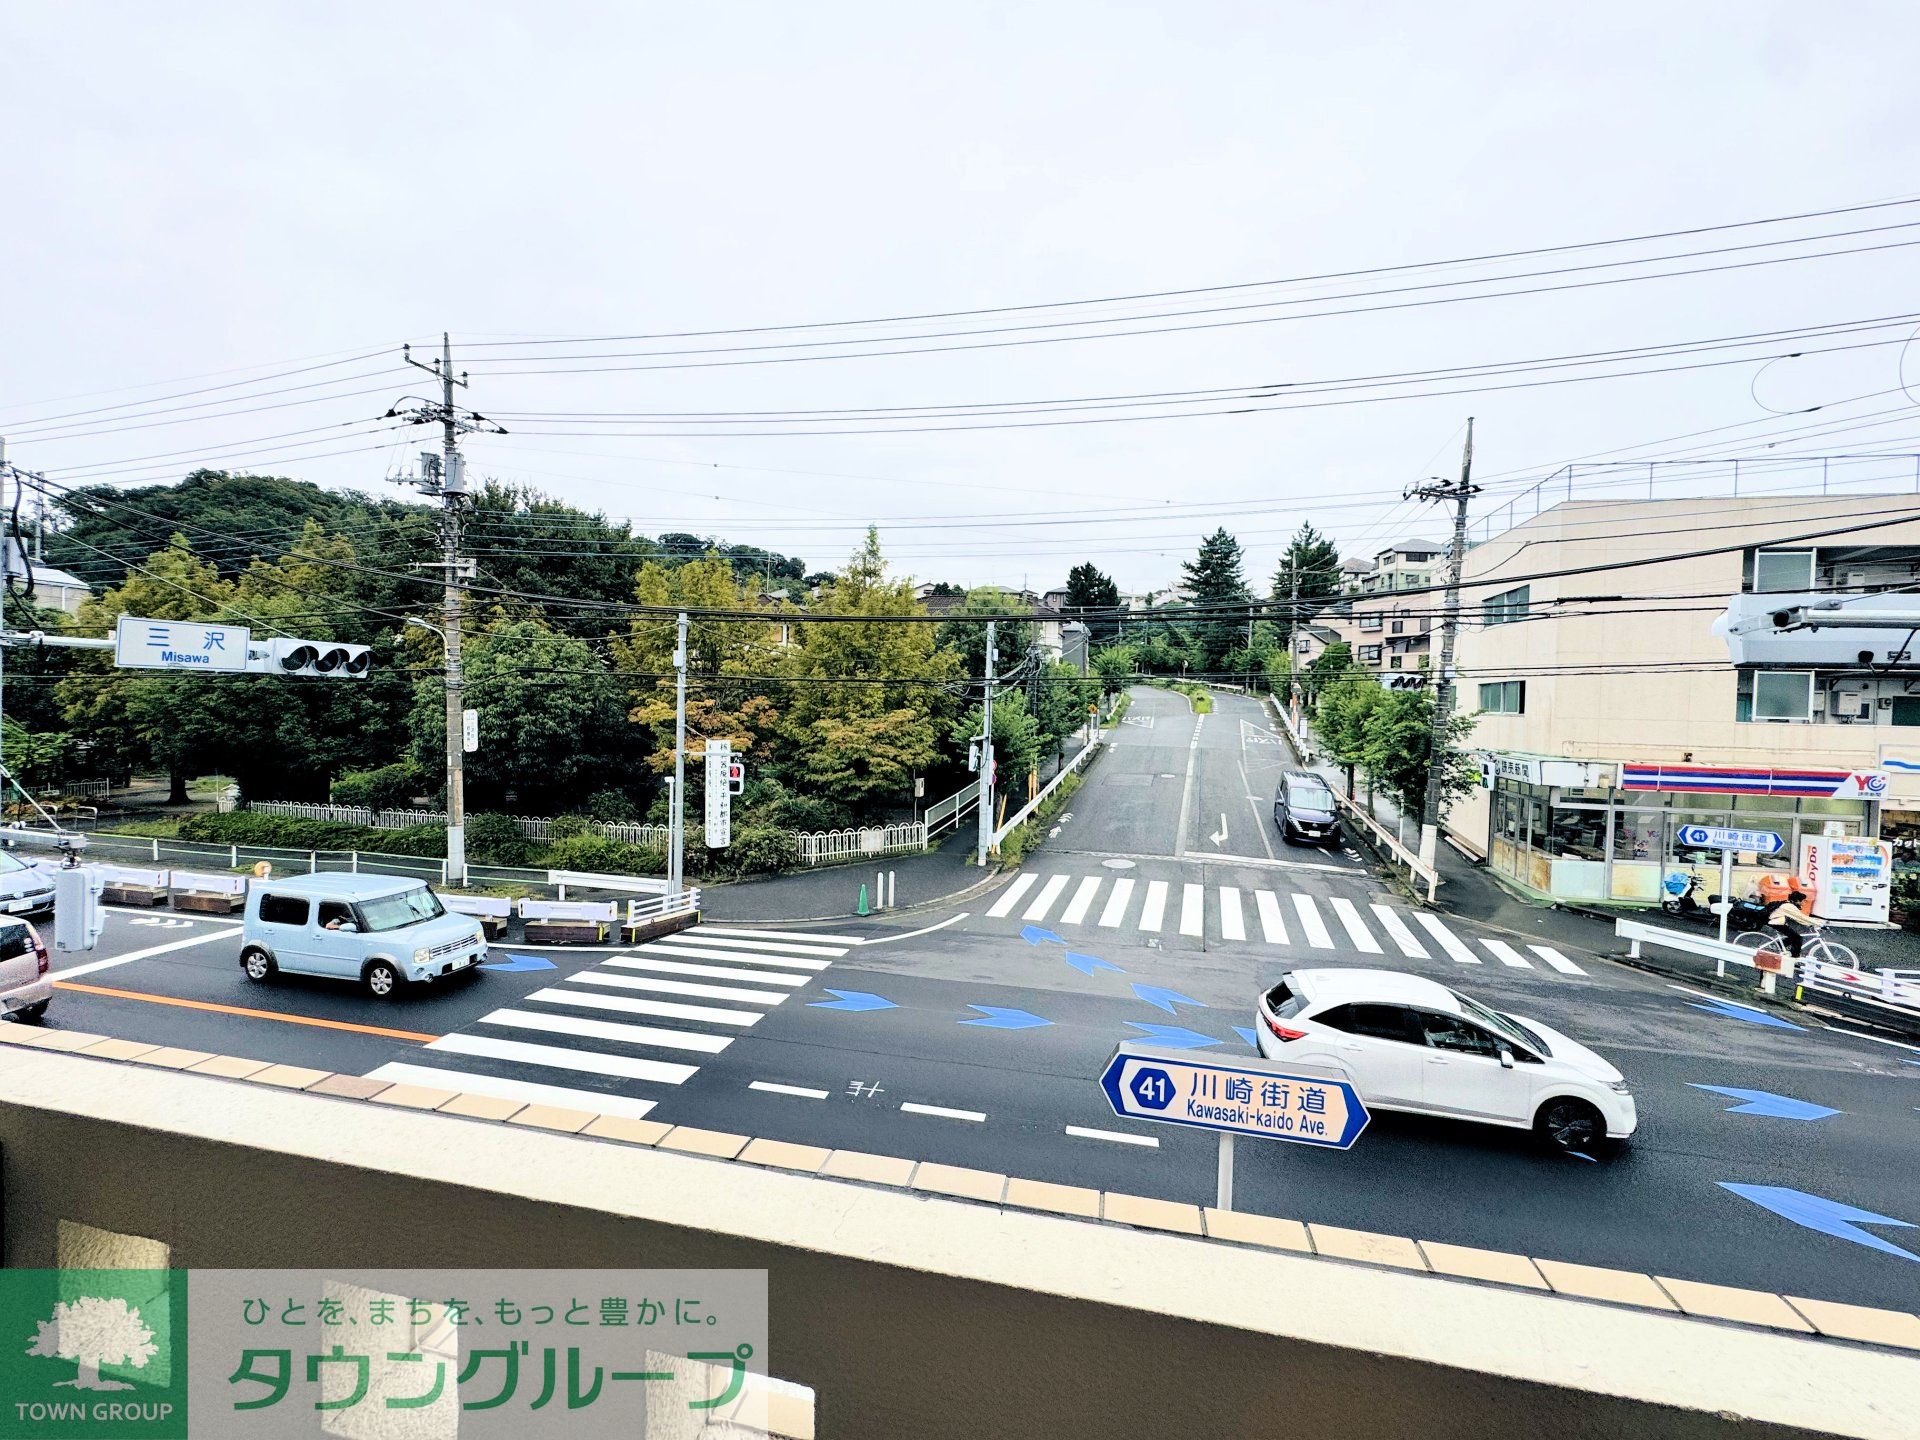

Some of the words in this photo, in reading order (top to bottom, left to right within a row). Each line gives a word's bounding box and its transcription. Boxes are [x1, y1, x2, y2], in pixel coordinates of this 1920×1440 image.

[146, 627, 226, 651] 三沢
[161, 651, 210, 664] Misawa
[1693, 832, 1705, 841] 41
[1714, 831, 1767, 844] 川崎街道
[1809, 846, 1819, 882] DyDo
[1138, 1076, 1166, 1102] 41
[1190, 1072, 1327, 1115] 川崎街道
[1187, 1099, 1294, 1131] Kawasaki-kaido
[1299, 1114, 1328, 1136] Ave.
